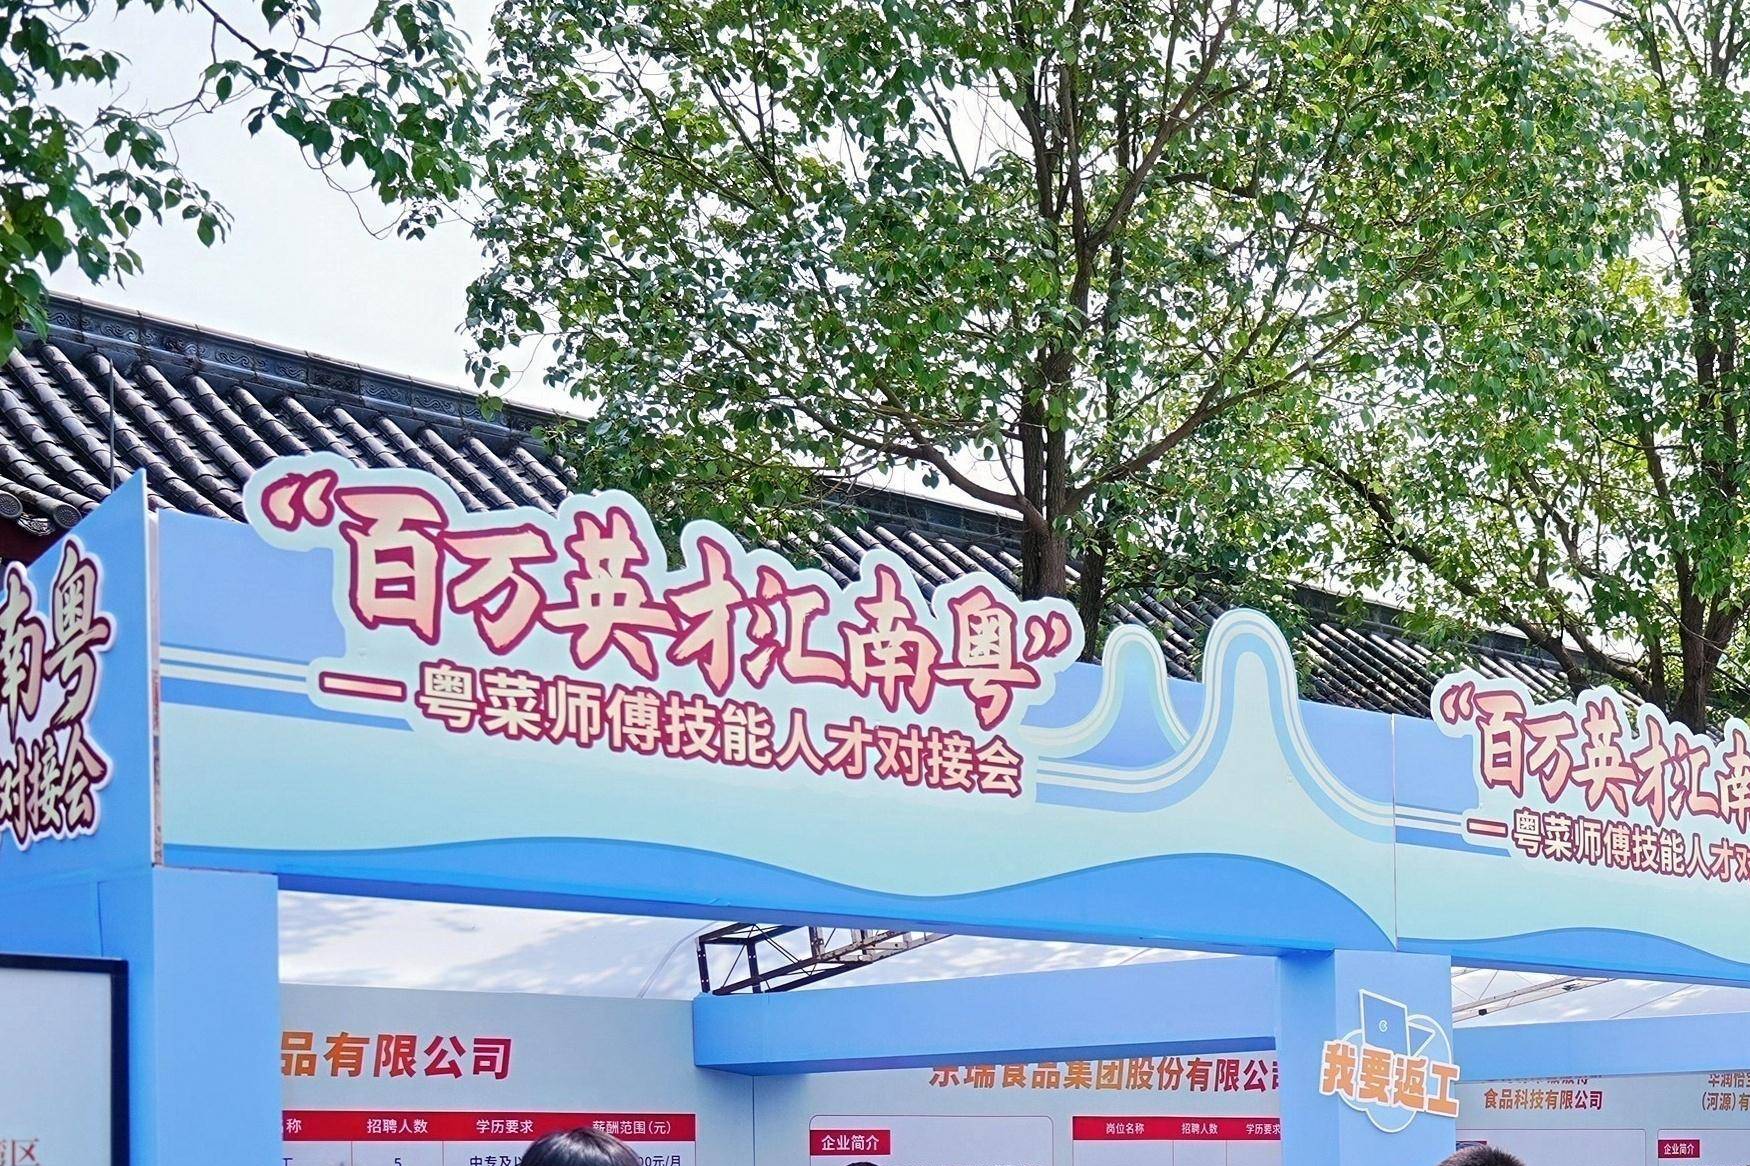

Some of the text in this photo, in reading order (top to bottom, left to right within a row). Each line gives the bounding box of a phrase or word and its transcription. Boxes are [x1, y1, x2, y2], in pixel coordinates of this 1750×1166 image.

[262, 466, 1070, 729] “百万英才汇南粤”
[280, 1031, 513, 1080] 品有限公司
[1322, 1041, 1460, 1117] 我要返工
[1484, 1088, 1603, 1110] 食品科技有限公司
[281, 1118, 302, 1134] 称
[367, 1119, 428, 1134] 招聘人数
[476, 1119, 534, 1135] 学历要求
[1106, 1122, 1145, 1134] 岗位名称
[1181, 1123, 1218, 1135] 招聘人数
[821, 1135, 879, 1151] 企业简介
[1664, 1143, 1695, 1155] 企业简介
